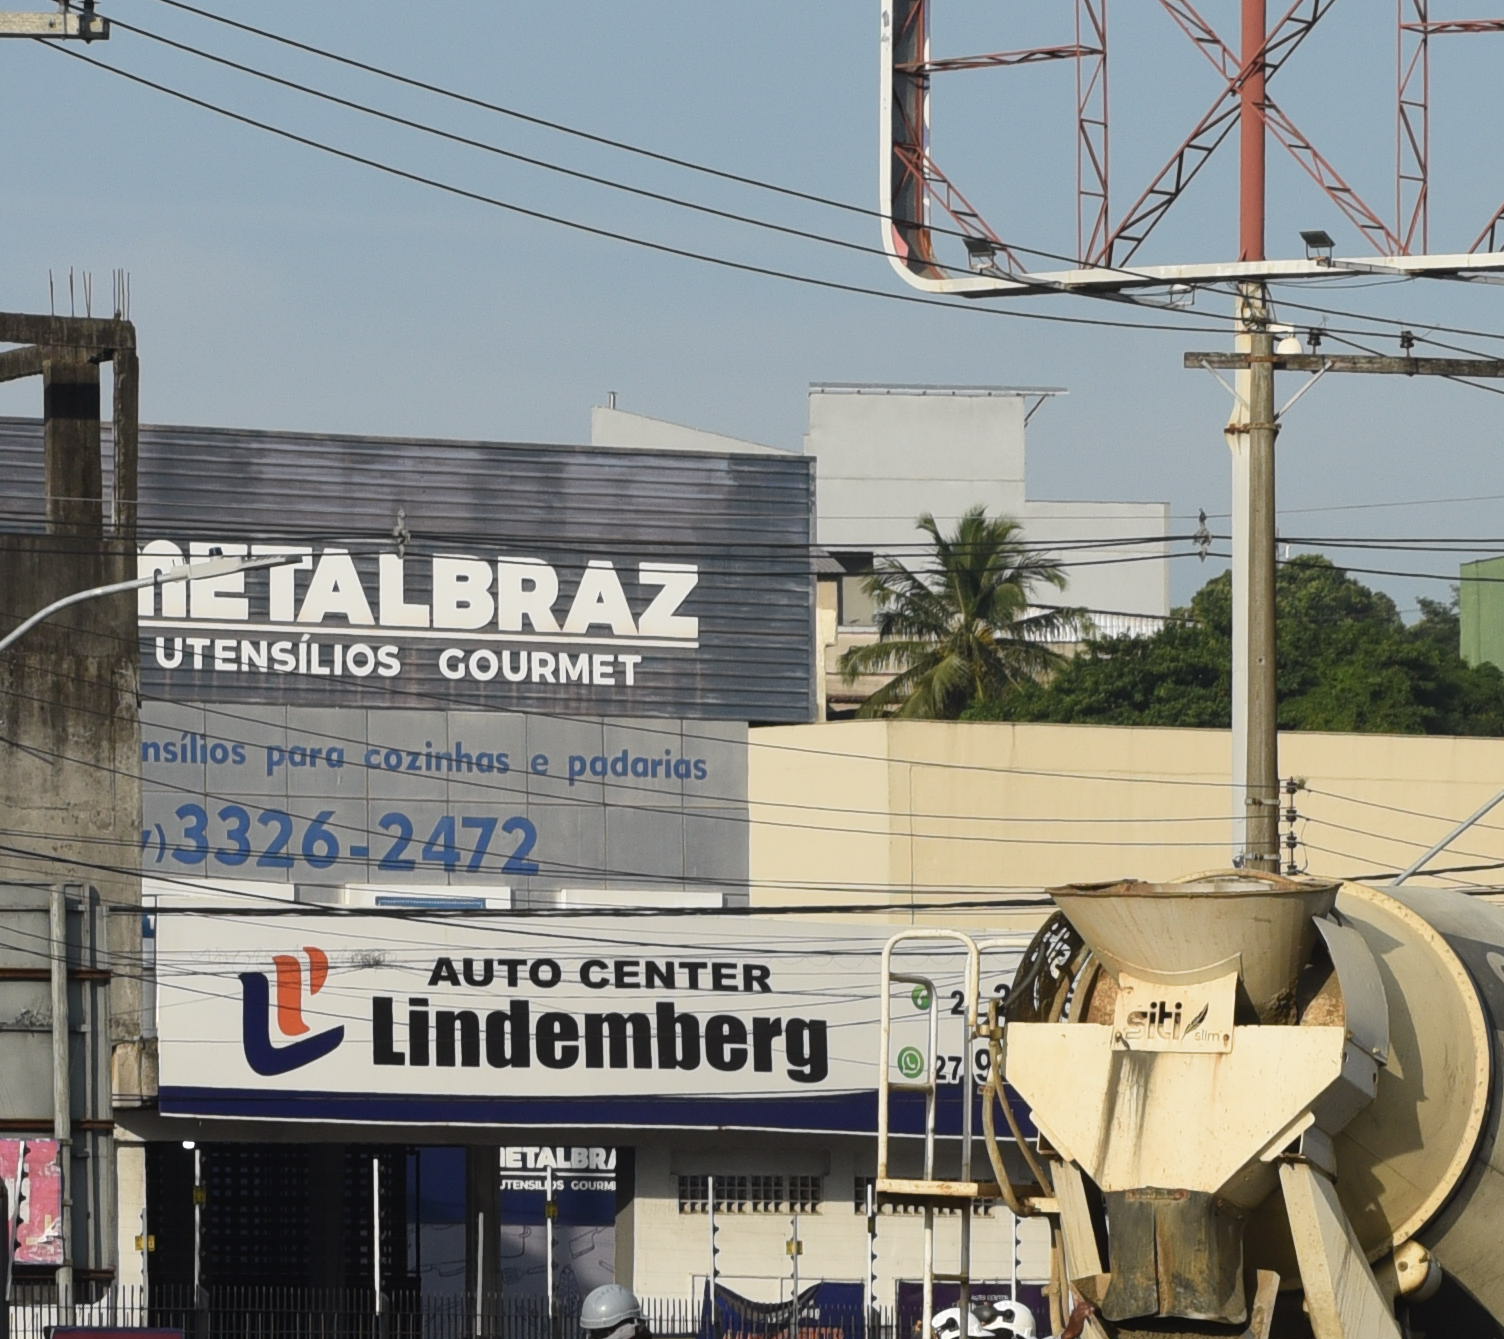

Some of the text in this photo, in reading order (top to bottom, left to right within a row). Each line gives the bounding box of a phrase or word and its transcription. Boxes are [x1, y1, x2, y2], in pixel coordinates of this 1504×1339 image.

[155, 633, 642, 687] UTENSÍLIOS GOURMET
[141, 732, 708, 786] nsílios para cozinhas e padarias
[141, 803, 540, 876] )3326-2472
[428, 957, 774, 993] AUTO CENTER
[372, 995, 829, 1083] Lindemberg
